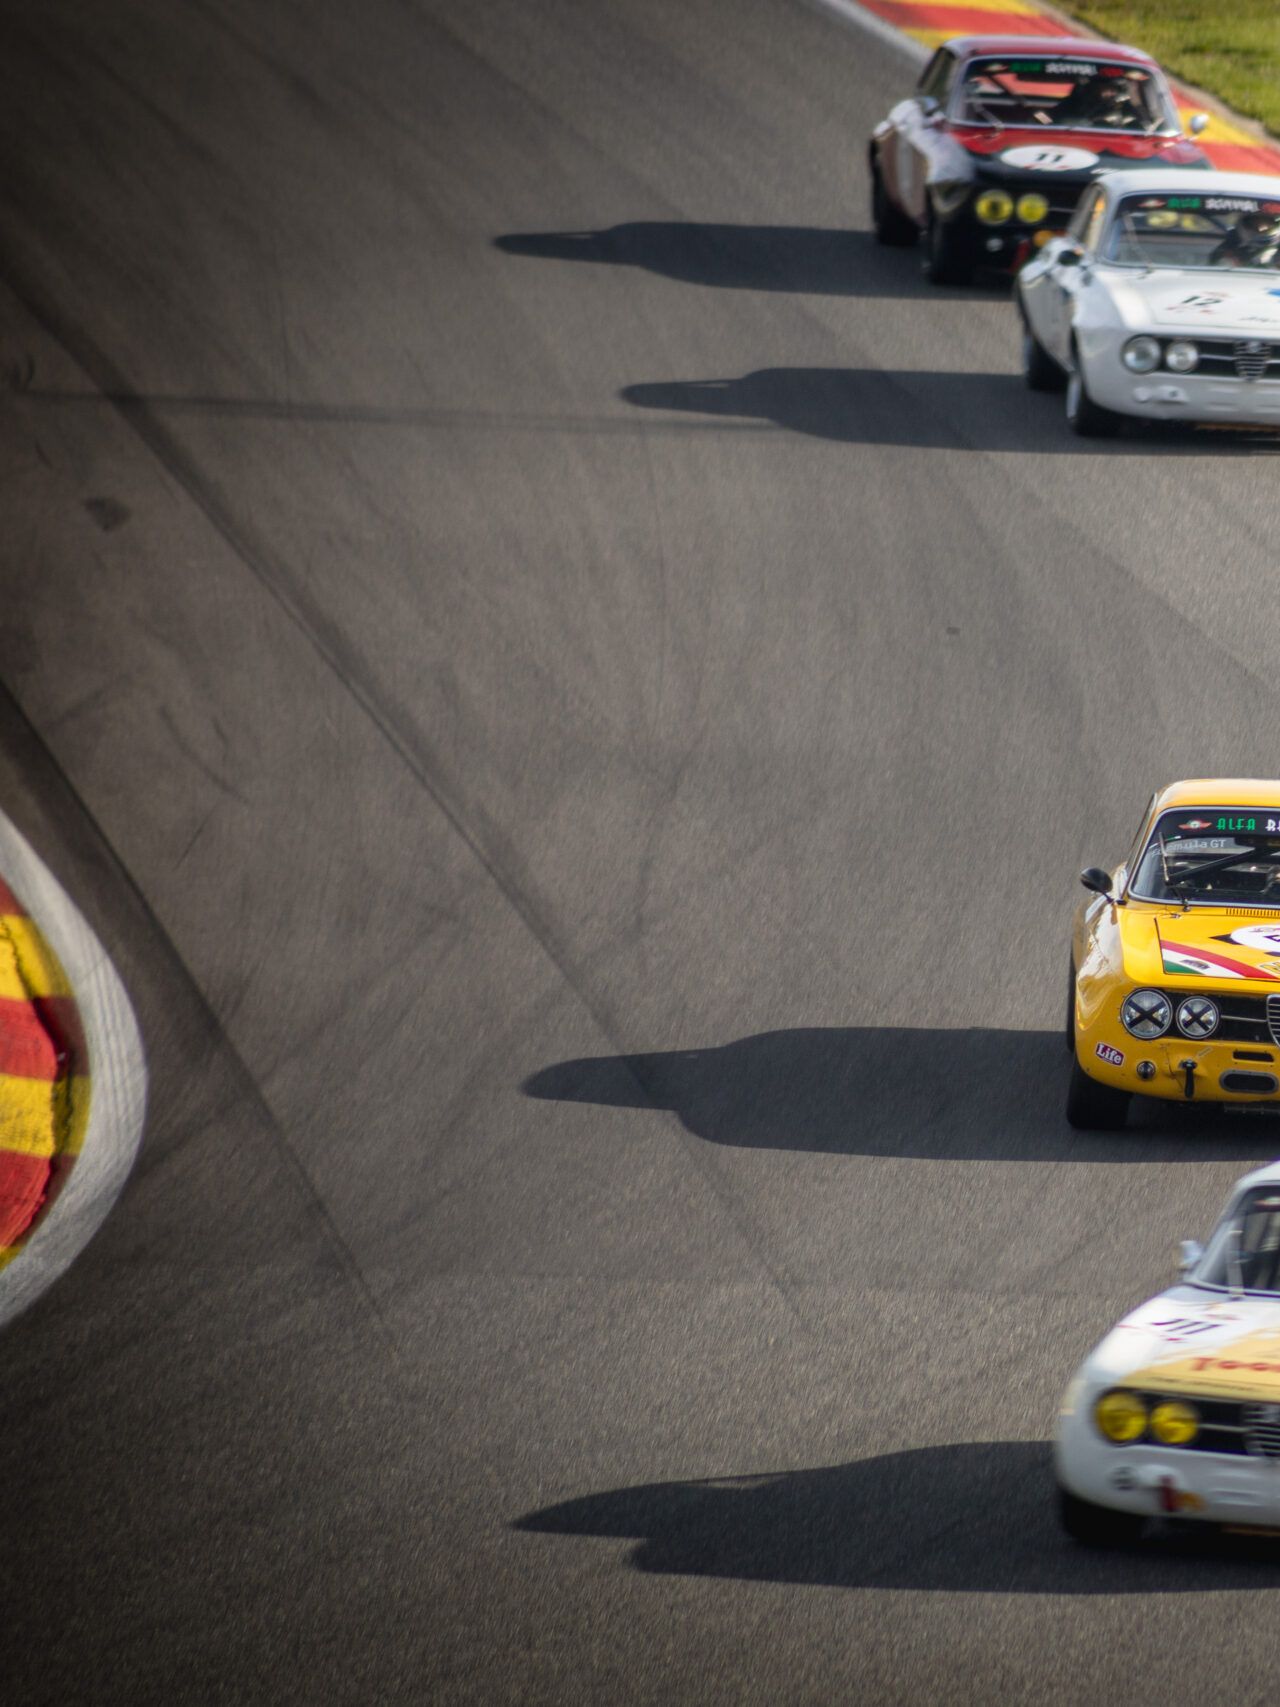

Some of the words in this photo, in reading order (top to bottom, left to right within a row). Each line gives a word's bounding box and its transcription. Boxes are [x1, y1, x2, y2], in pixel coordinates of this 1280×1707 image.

[1216, 817, 1257, 831] ALFA
[1210, 839, 1226, 848] GT
[1097, 1043, 1122, 1064] Life
